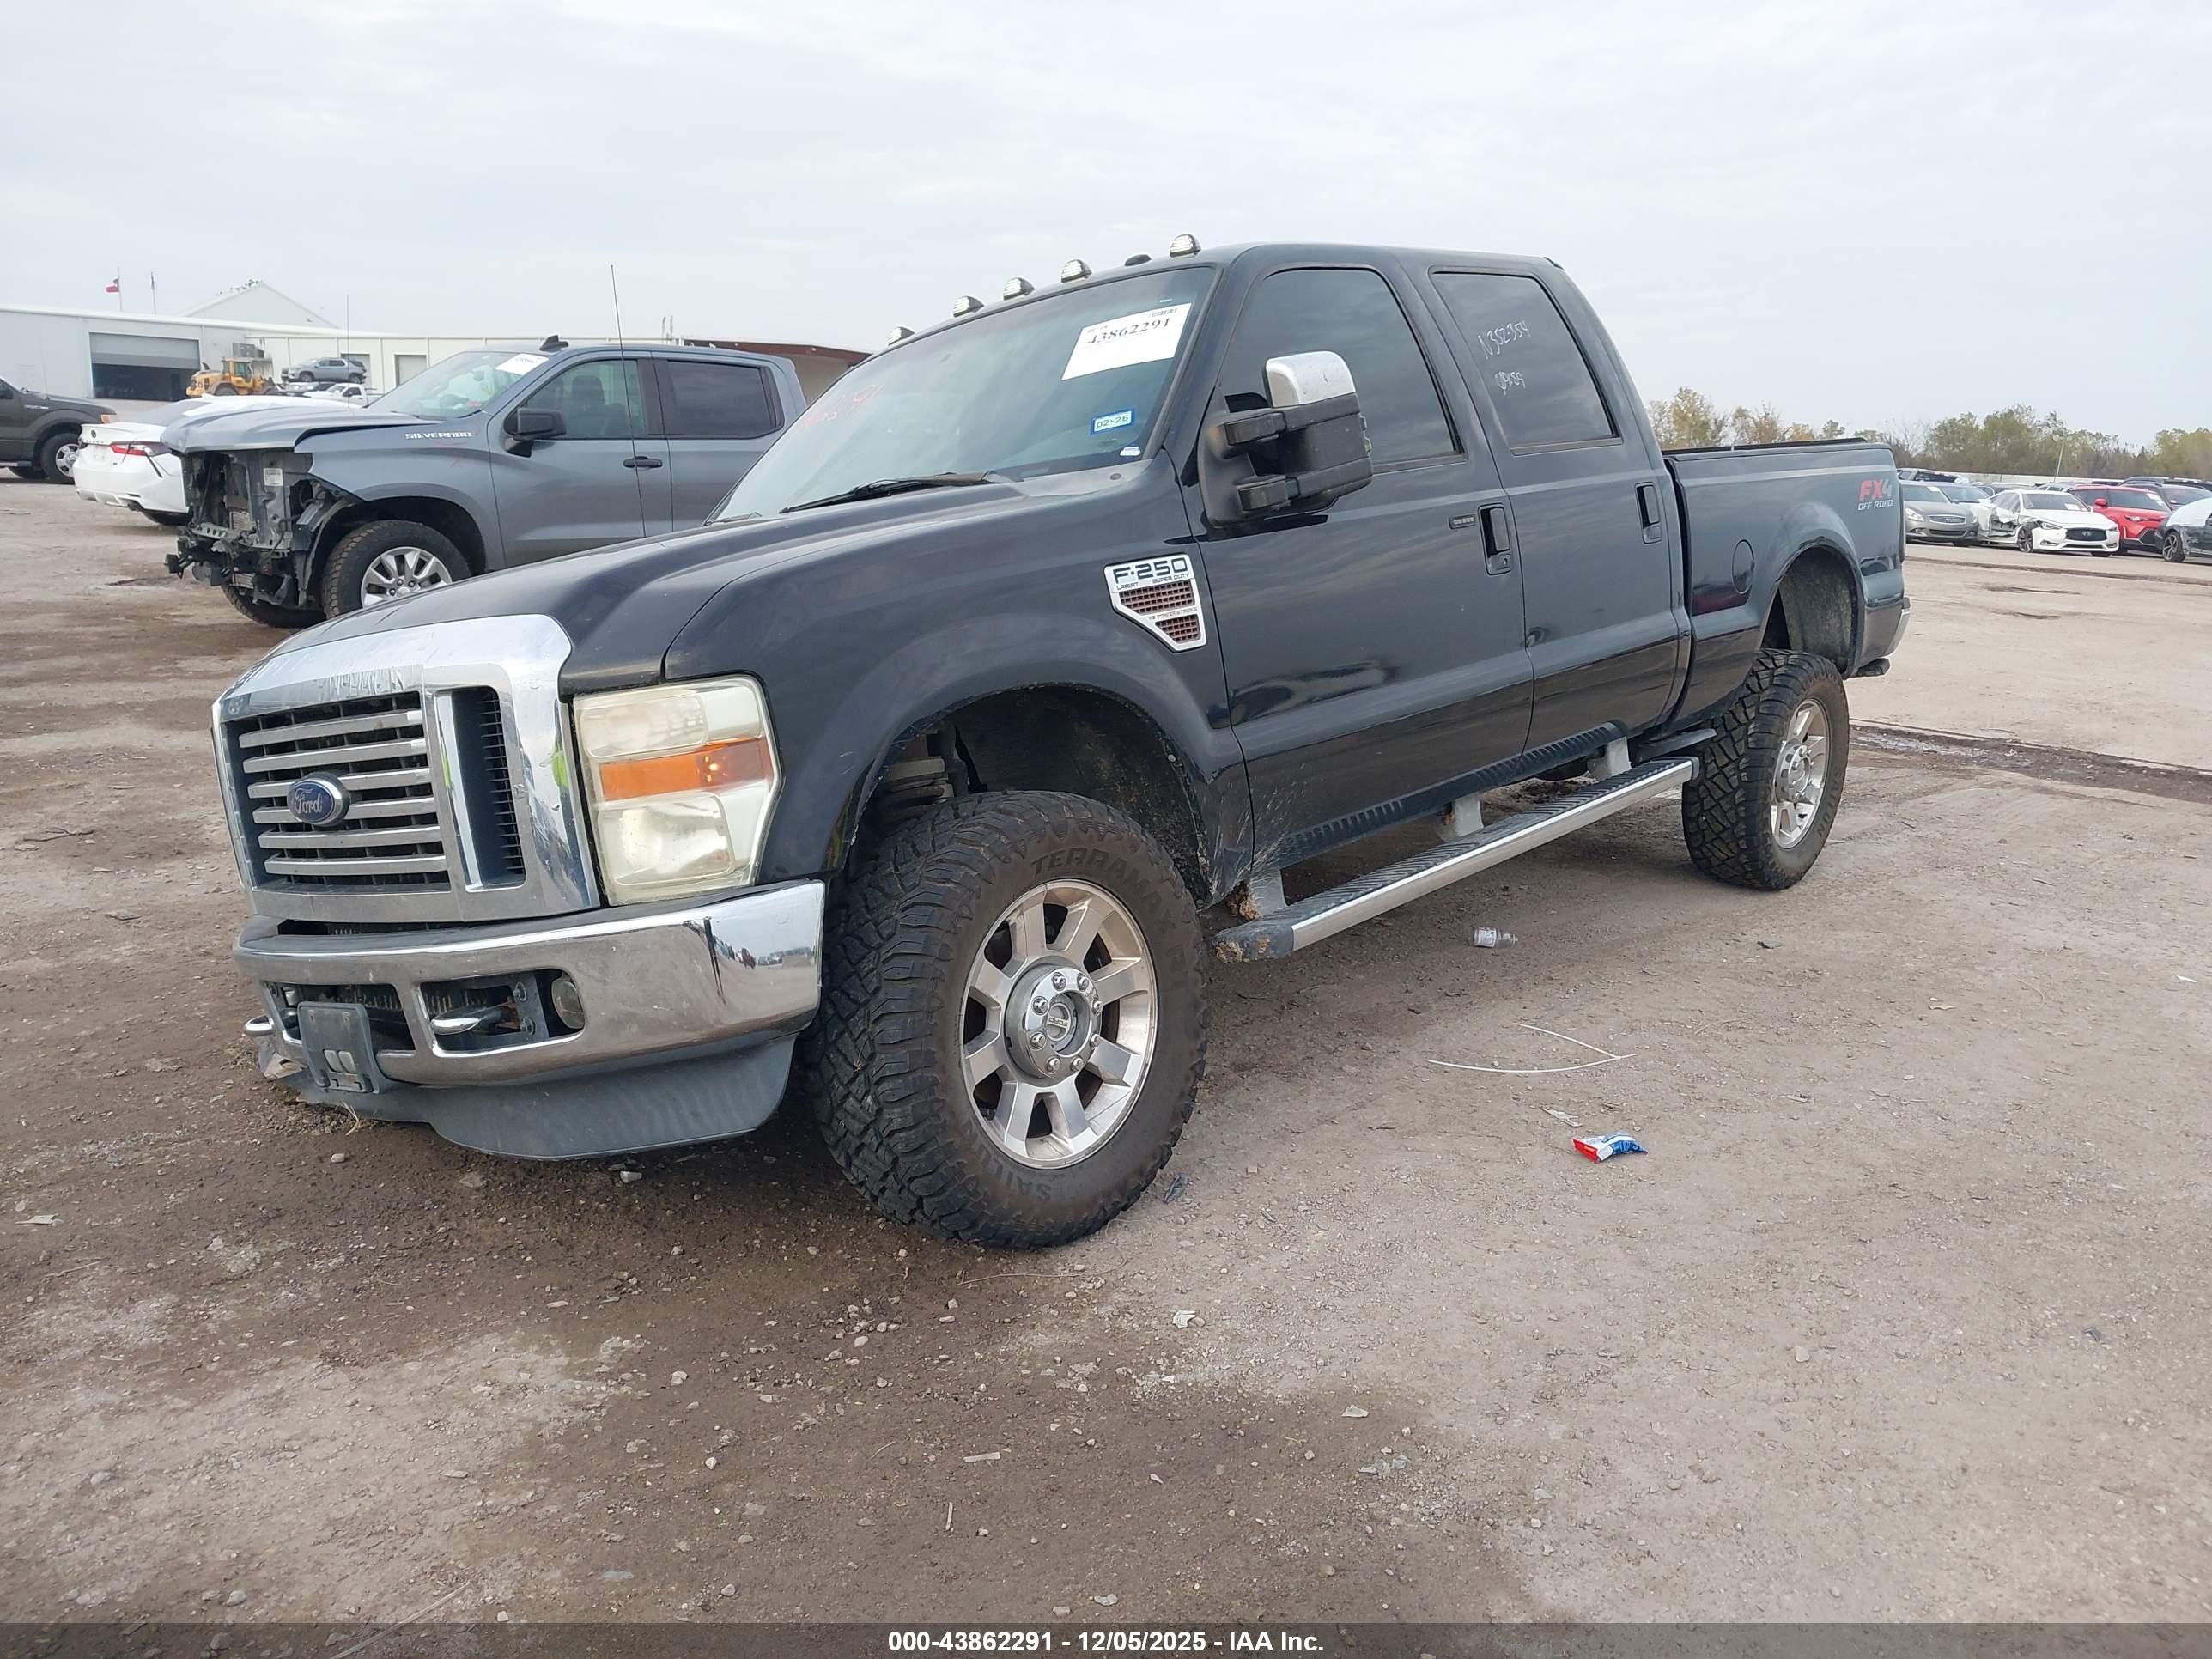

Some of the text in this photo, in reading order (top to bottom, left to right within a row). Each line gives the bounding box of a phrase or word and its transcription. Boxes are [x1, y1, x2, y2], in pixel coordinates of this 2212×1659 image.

[1087, 318, 1170, 343] 43862291
[1858, 479, 1893, 503] FX4
[1858, 499, 1893, 511] OFF ROAD
[1116, 581, 1139, 590] LARIAT
[1152, 572, 1189, 584] SUPER DUTY
[295, 787, 323, 814] Ford
[1030, 847, 1176, 933] TERRAMAX
